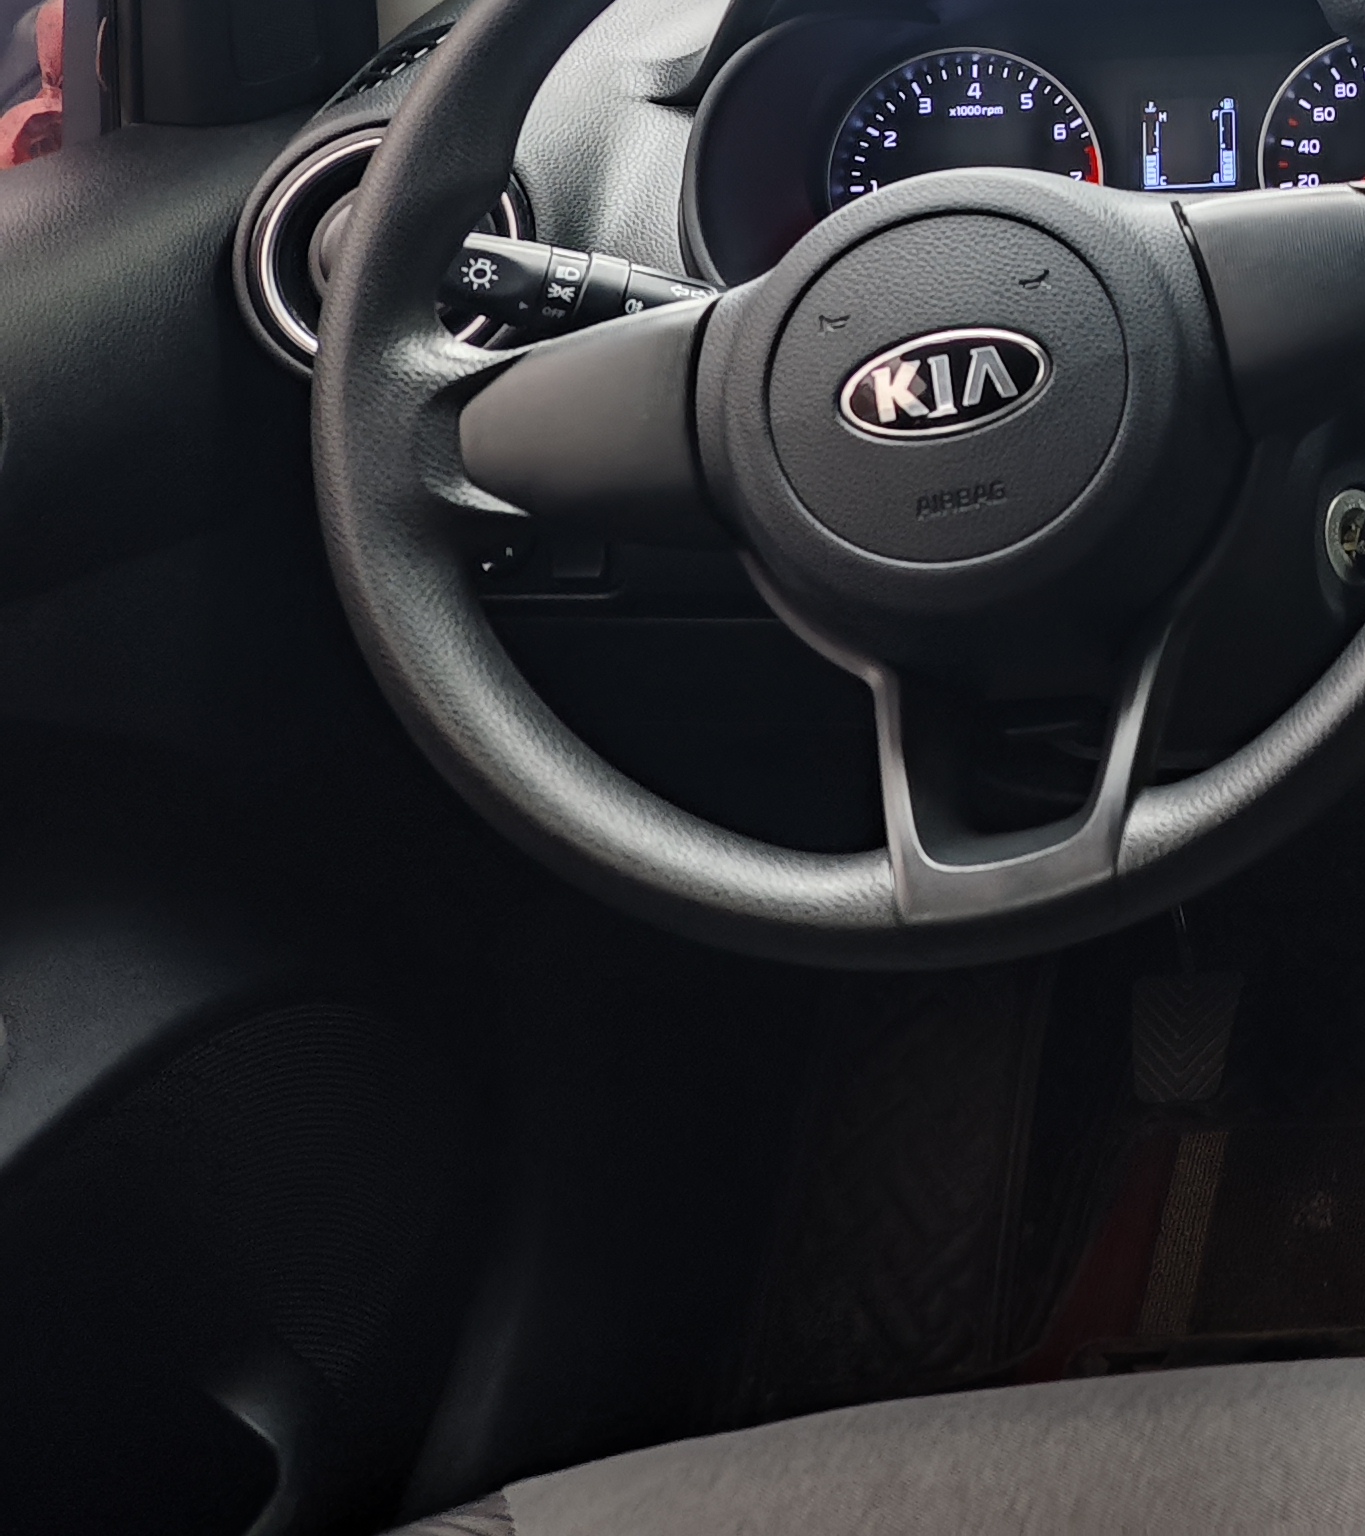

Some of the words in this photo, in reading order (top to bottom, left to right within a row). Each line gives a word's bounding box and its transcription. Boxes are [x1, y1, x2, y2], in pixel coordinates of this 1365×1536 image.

[966, 82, 982, 99] 4
[1334, 83, 1357, 98] 80
[918, 97, 932, 114] 3
[1020, 93, 1033, 110] 5
[1158, 111, 1167, 122] H
[1313, 107, 1335, 122] 60
[883, 130, 897, 148] 2
[1053, 123, 1067, 140] 6
[1298, 138, 1320, 154] 40
[1297, 174, 1319, 188] 20
[541, 306, 567, 318] OFF
[870, 344, 1020, 425] KIA
[915, 481, 1008, 521] AIRBAG
